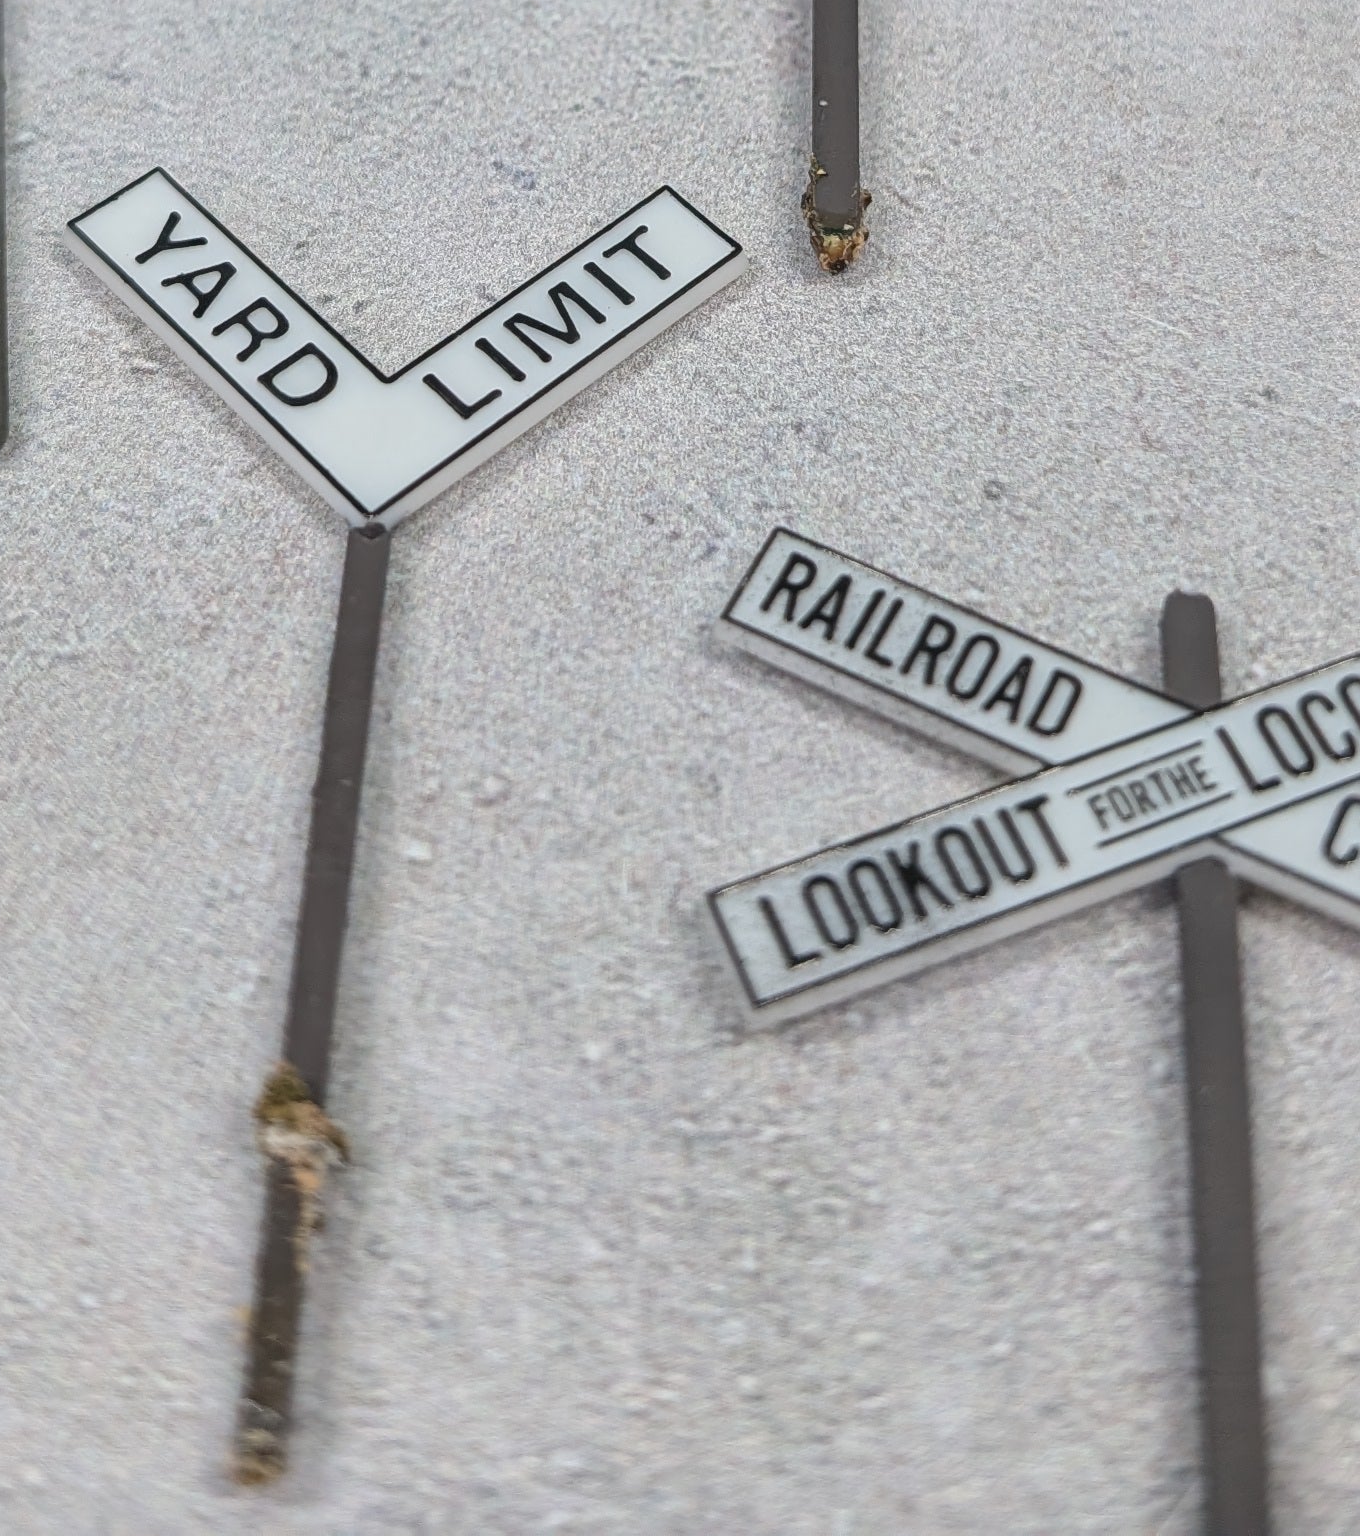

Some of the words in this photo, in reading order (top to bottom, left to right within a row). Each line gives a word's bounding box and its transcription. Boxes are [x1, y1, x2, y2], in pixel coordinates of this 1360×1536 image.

[134, 211, 339, 408] YARD
[422, 224, 672, 421] LIMIT
[758, 550, 1086, 741] RAILROAD
[758, 793, 1075, 971] LOOKOUT
